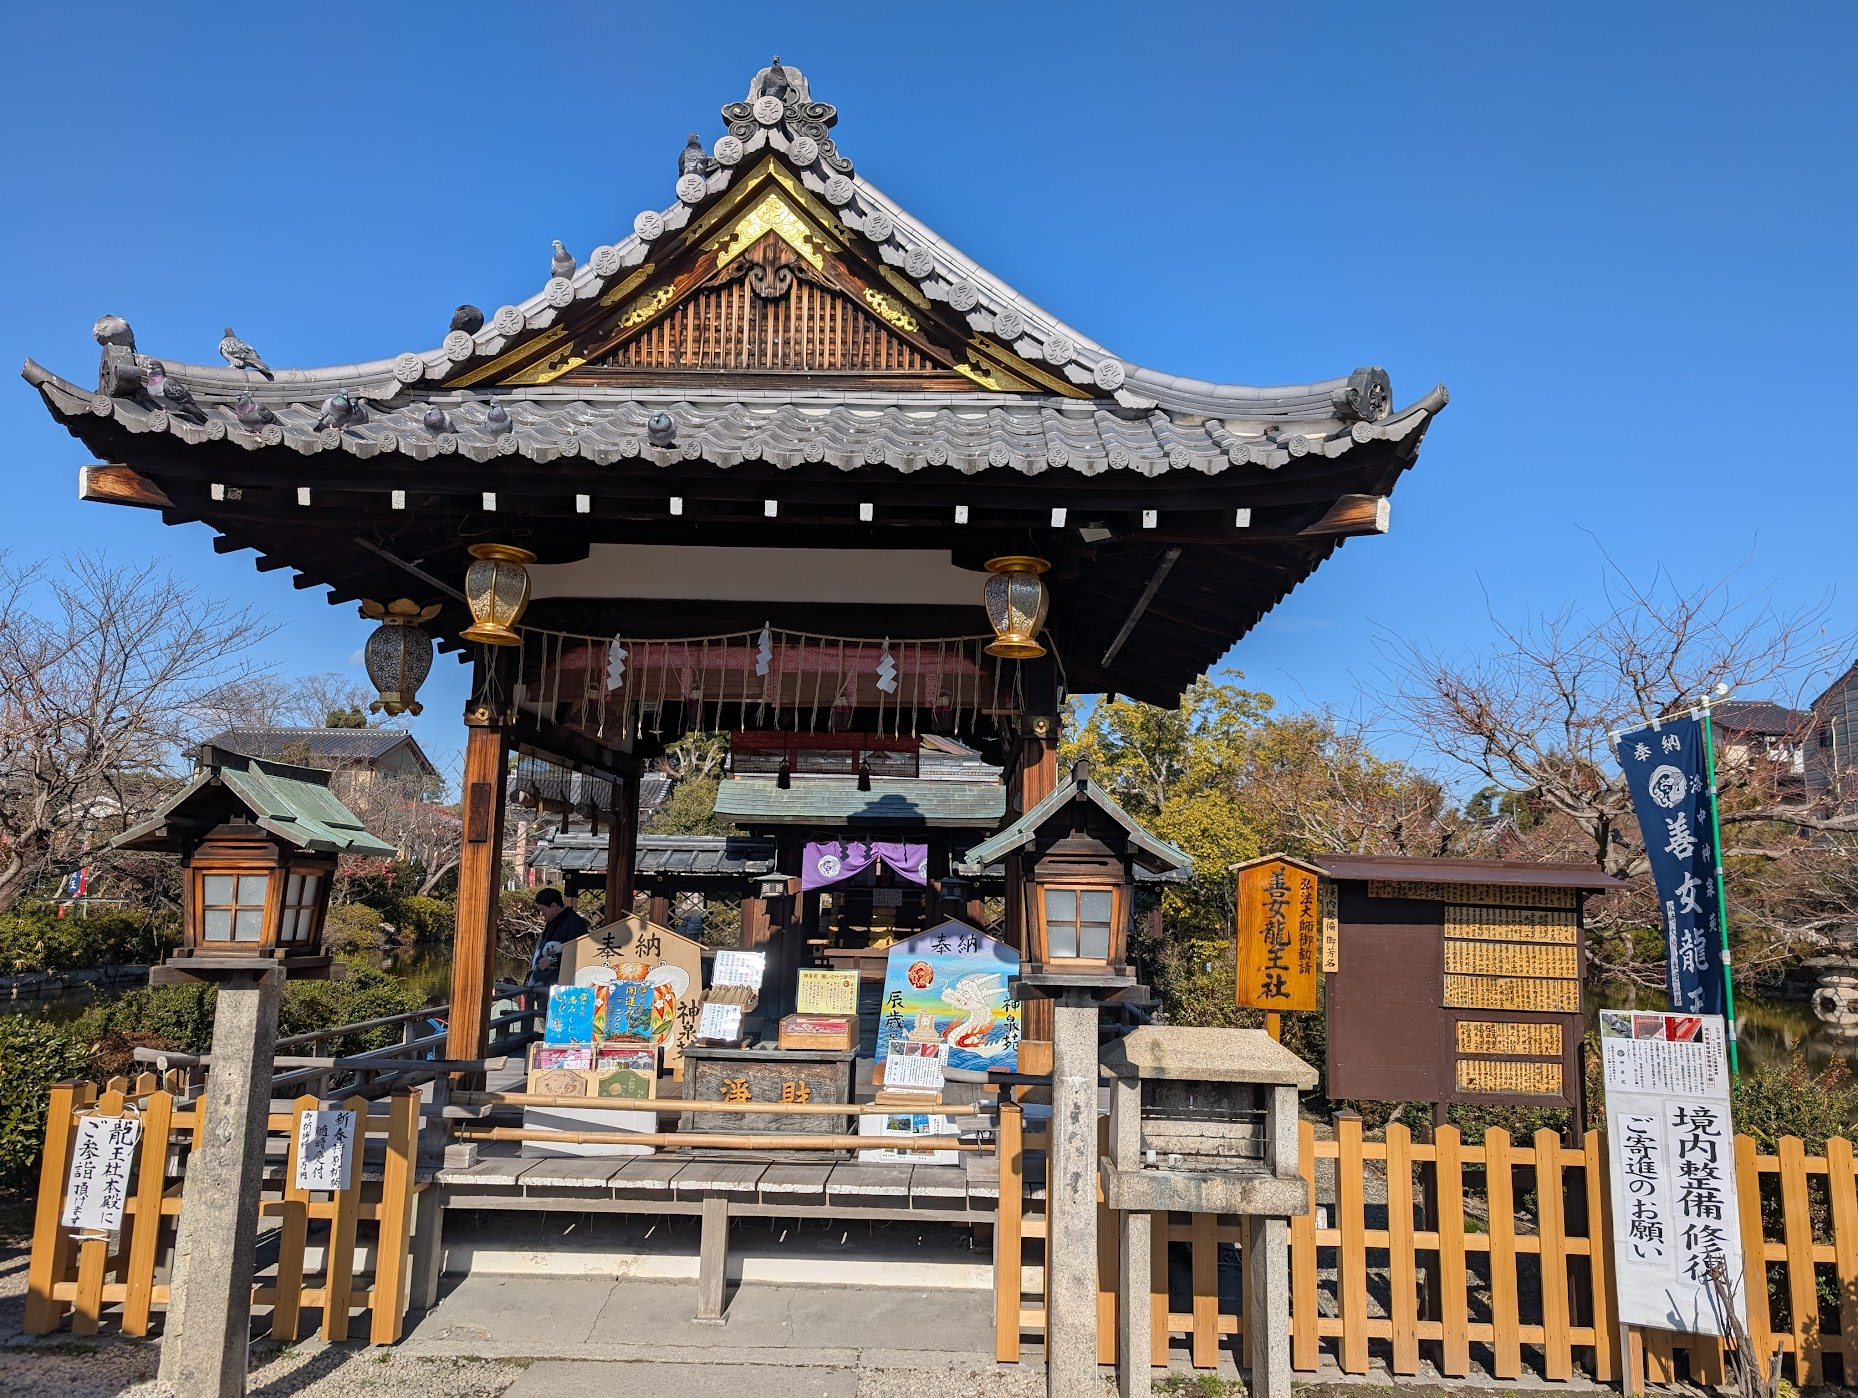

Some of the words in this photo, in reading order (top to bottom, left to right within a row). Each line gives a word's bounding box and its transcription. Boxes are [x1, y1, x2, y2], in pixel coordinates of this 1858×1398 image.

[1633, 734, 1681, 762] 奉納
[592, 932, 661, 959] 奉納
[931, 933, 978, 954] 奉納
[1257, 865, 1292, 1000] 善女龍王社
[1298, 878, 1314, 975] 弘法大師御勧請
[1324, 887, 1337, 968] 境内整備御芳名
[71, 1120, 108, 1227] ご参詣頂けます
[99, 1120, 134, 1224] 龍王社本殿に
[1623, 1117, 1664, 1259] ご寄進のお願い
